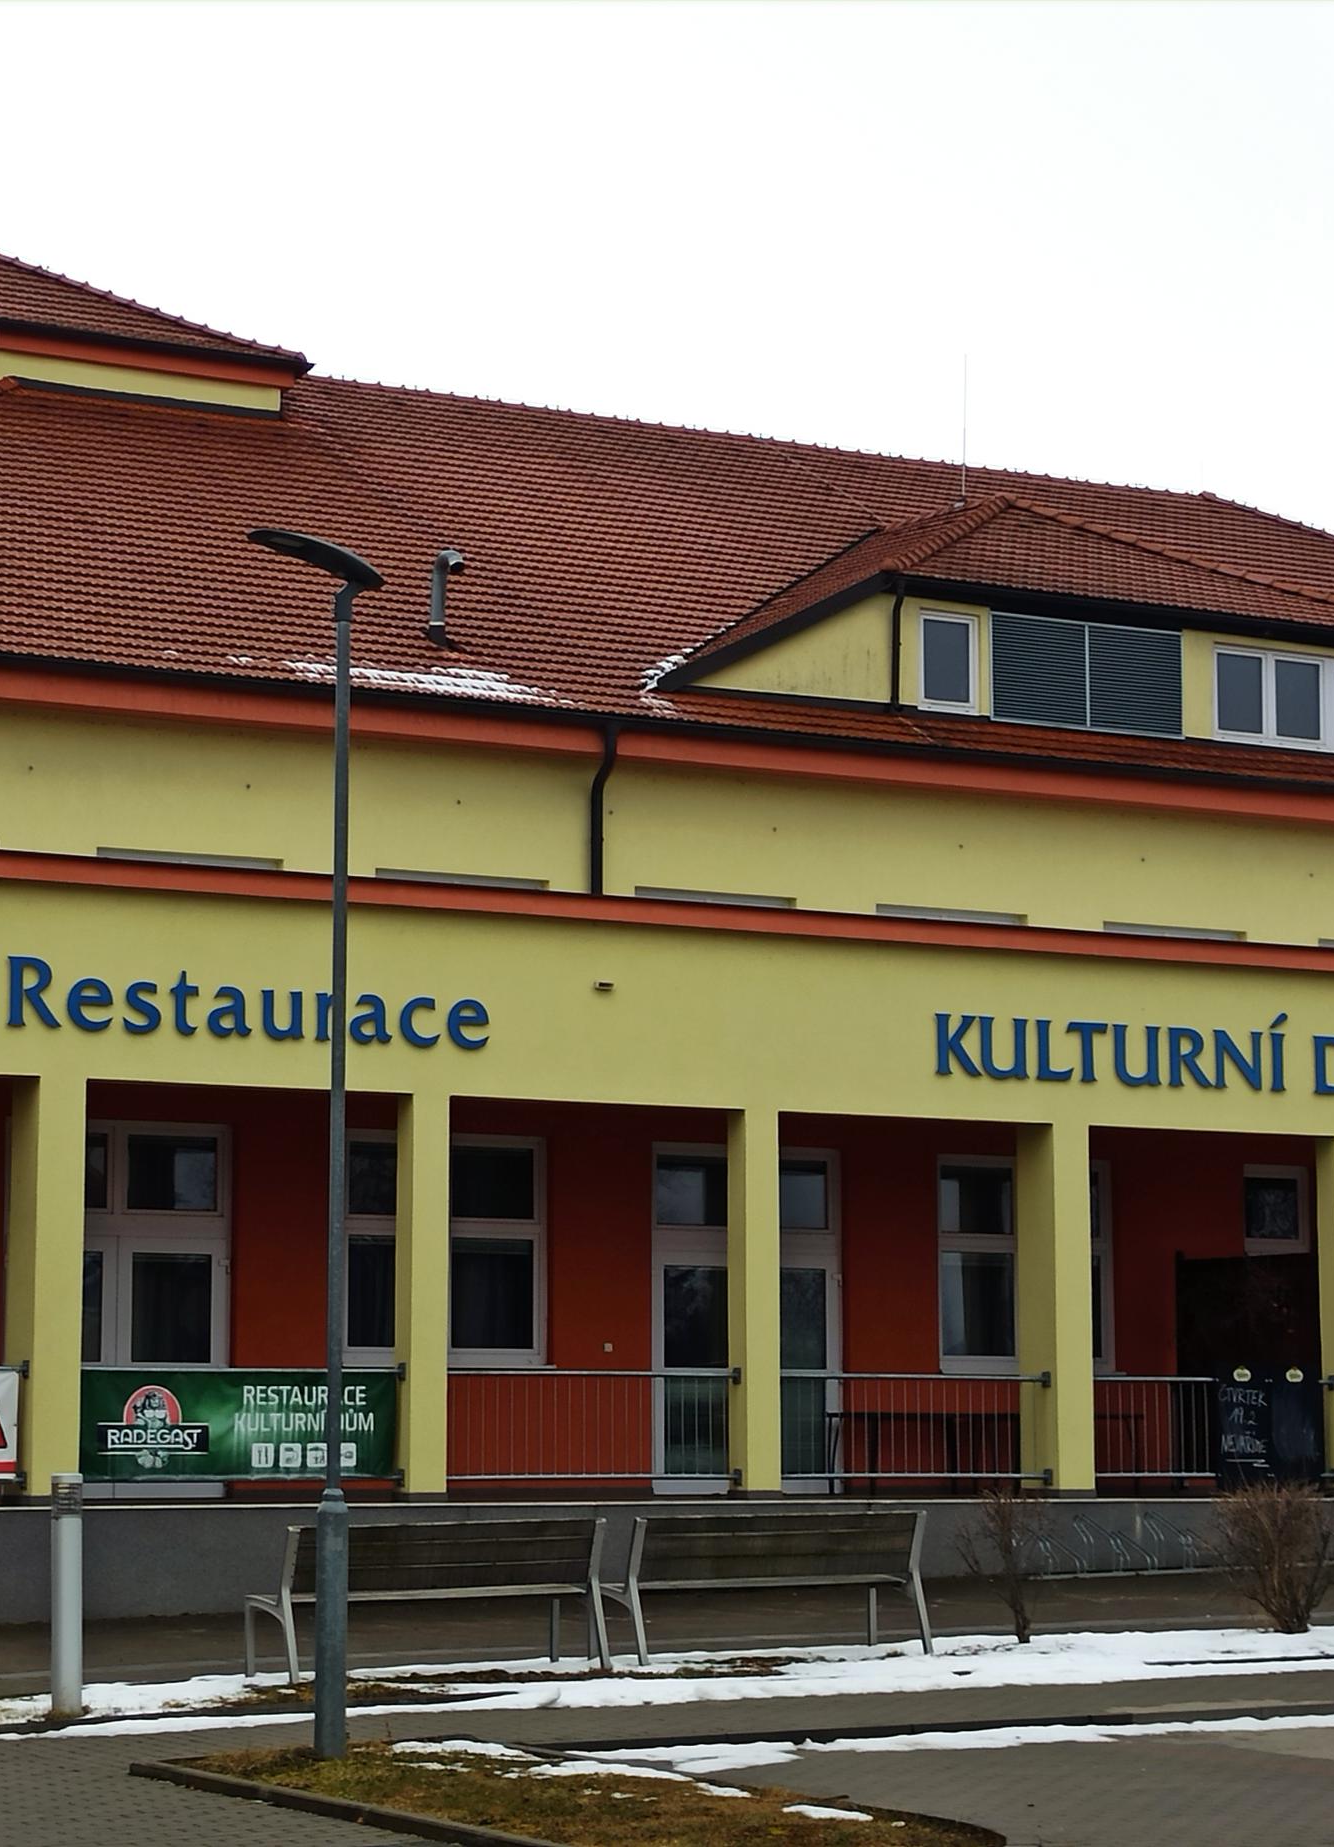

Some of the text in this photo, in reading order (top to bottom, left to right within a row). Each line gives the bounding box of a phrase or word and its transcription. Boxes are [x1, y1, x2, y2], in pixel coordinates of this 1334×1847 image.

[6, 954, 490, 1051] Restaurace
[934, 1011, 1289, 1092] KULTURNÍ
[242, 1385, 367, 1406] RESTAURCE
[234, 1408, 327, 1432] KULTURNÍ
[107, 1428, 203, 1450] RADEGAST
